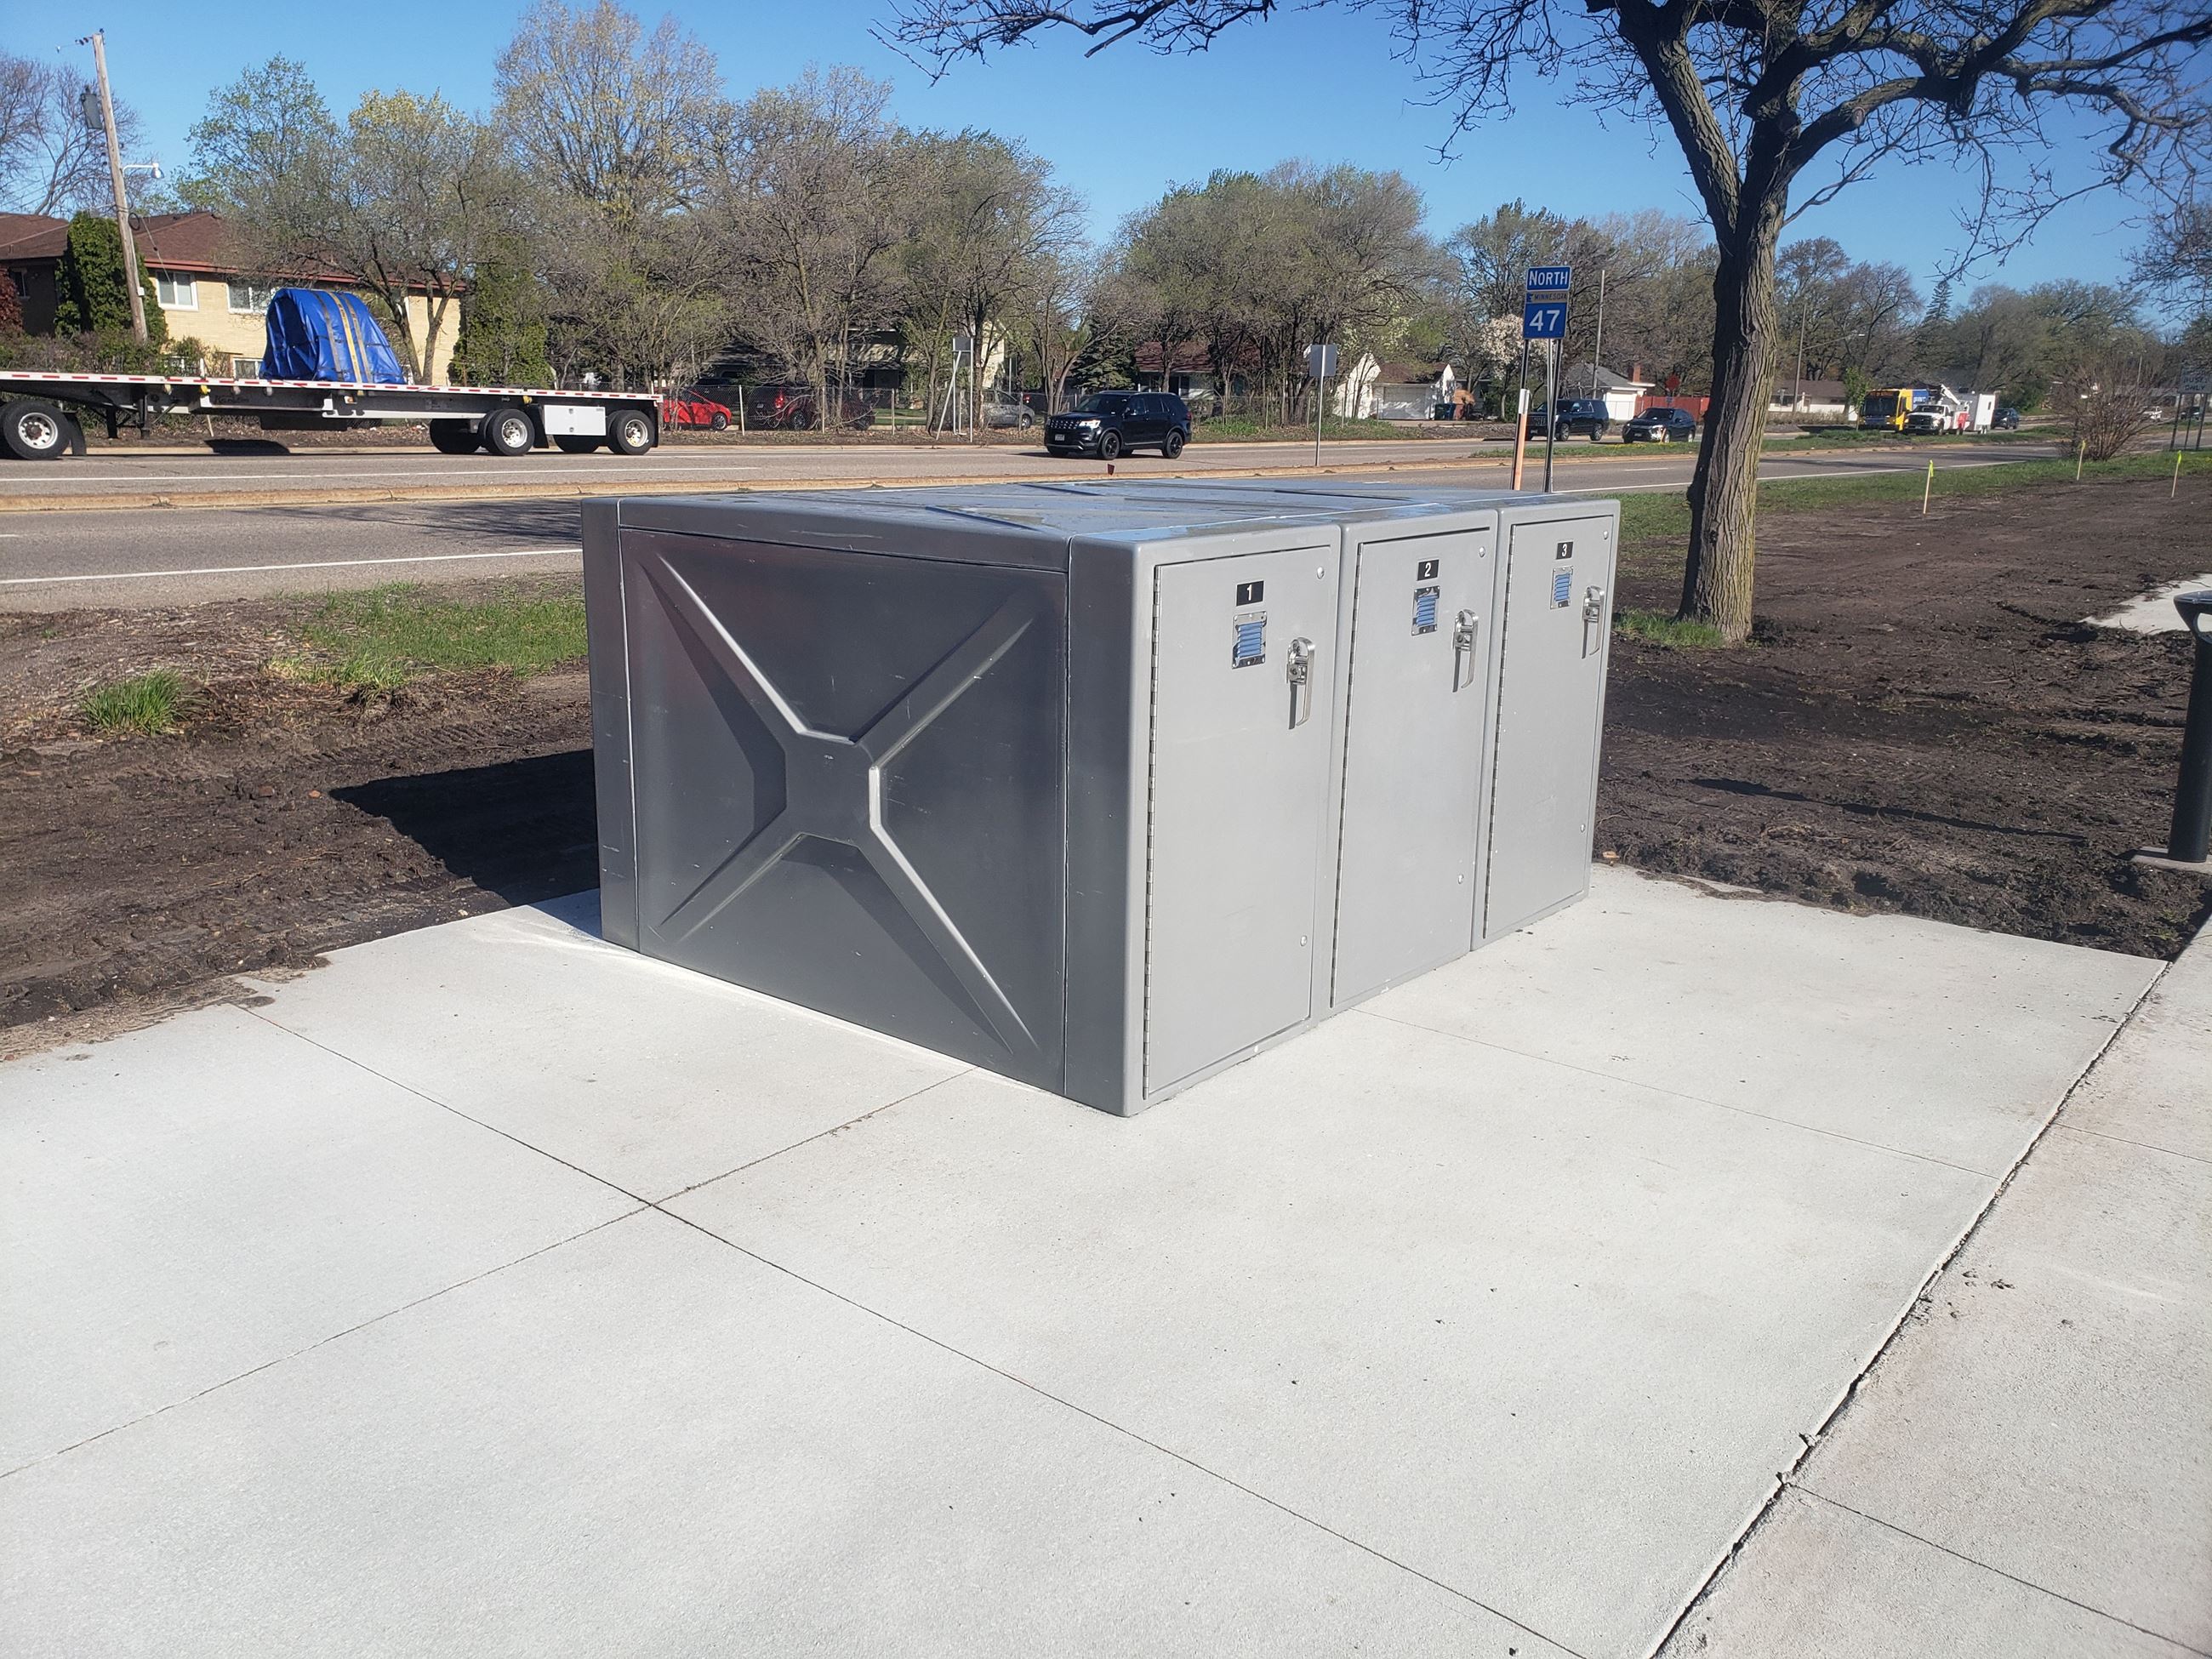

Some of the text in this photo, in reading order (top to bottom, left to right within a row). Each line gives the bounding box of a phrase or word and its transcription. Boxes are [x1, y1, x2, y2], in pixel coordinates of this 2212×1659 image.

[1529, 271, 1568, 286] NORTH
[1529, 310, 1560, 332] 47
[1561, 543, 1568, 557] 3
[1424, 562, 1432, 578] 2
[1246, 584, 1252, 601] 1
